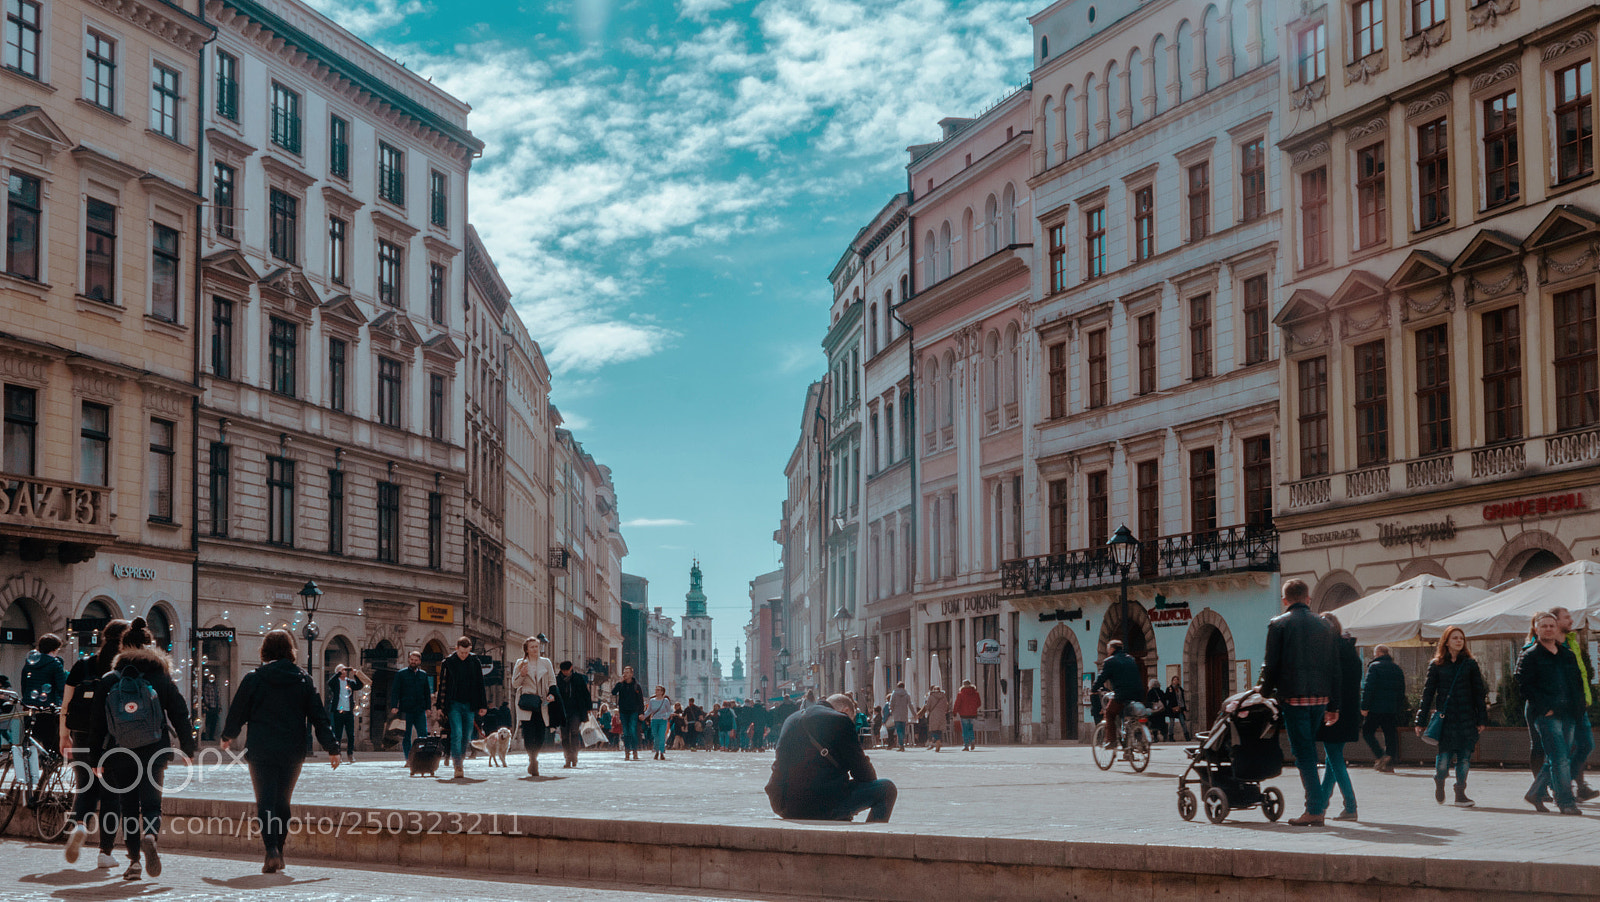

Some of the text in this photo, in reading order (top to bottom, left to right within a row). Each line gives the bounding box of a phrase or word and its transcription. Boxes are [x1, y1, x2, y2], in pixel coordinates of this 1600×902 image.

[69, 487, 94, 525] 13
[1482, 492, 1587, 521] GRANDE GRILL
[112, 562, 157, 580] NESPRESSO
[195, 629, 234, 639] NESPRESSO
